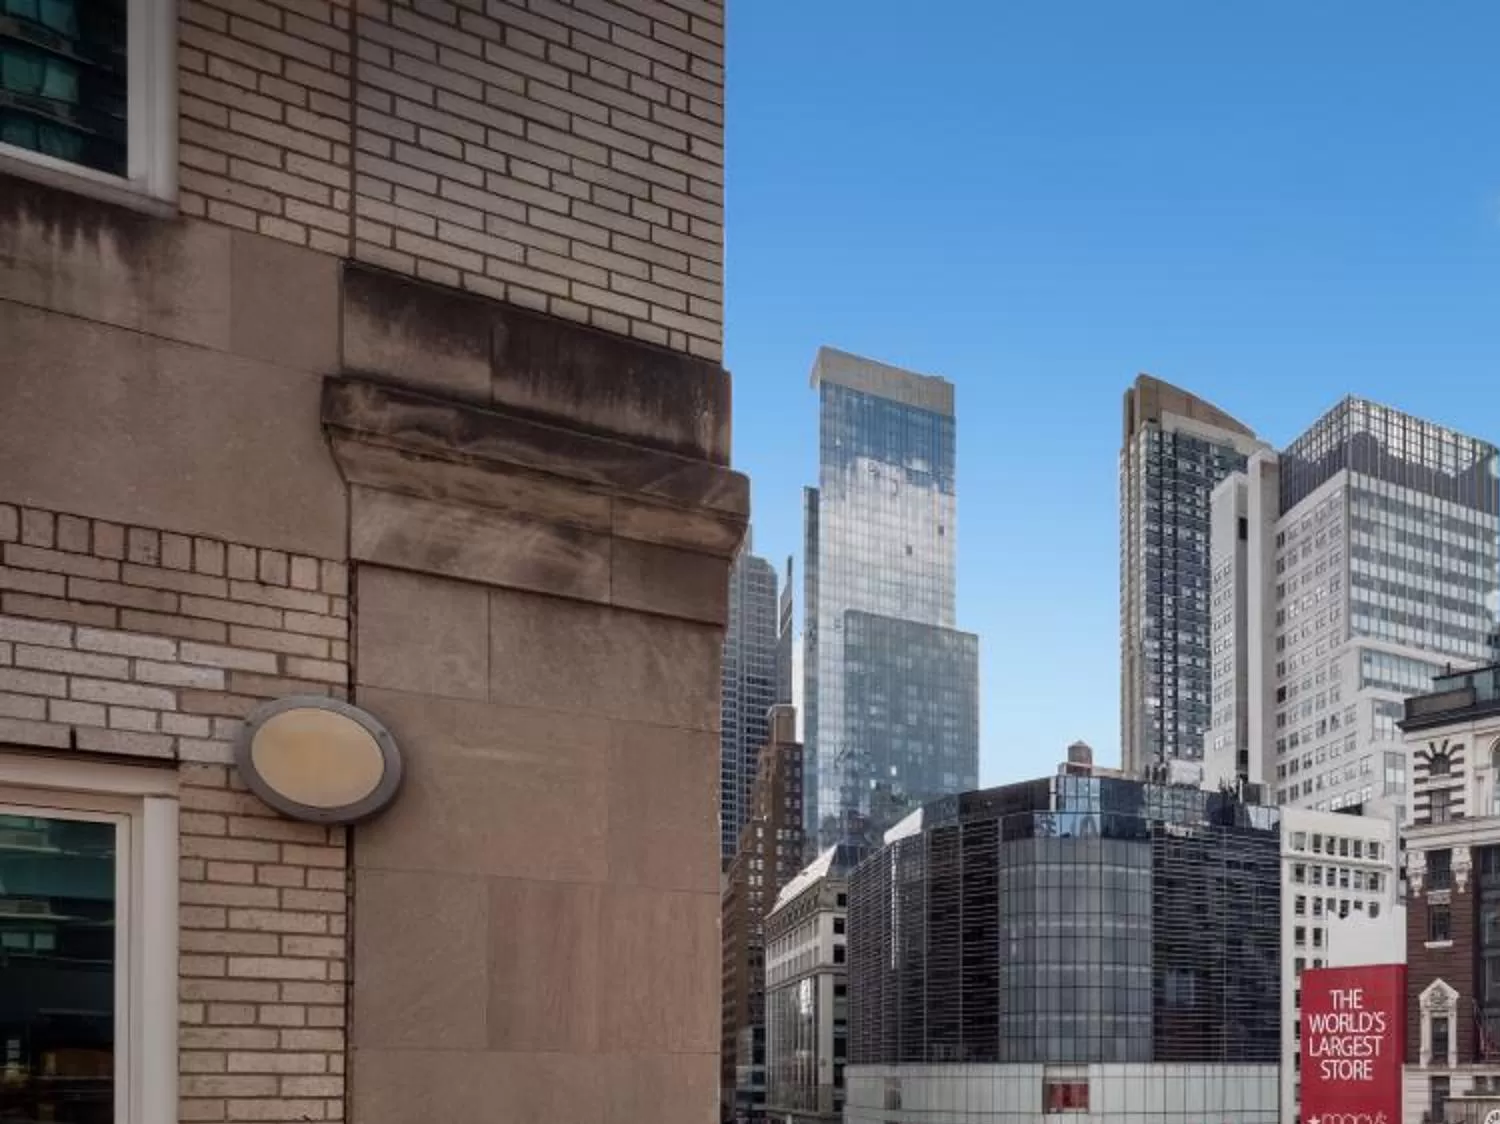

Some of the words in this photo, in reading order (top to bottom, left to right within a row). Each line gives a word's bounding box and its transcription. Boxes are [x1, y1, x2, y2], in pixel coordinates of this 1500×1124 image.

[1329, 988, 1364, 1010] THE
[1308, 1011, 1386, 1034] WORLD'S
[1308, 1035, 1384, 1057] LARGEST
[1320, 1059, 1373, 1081] STORE
